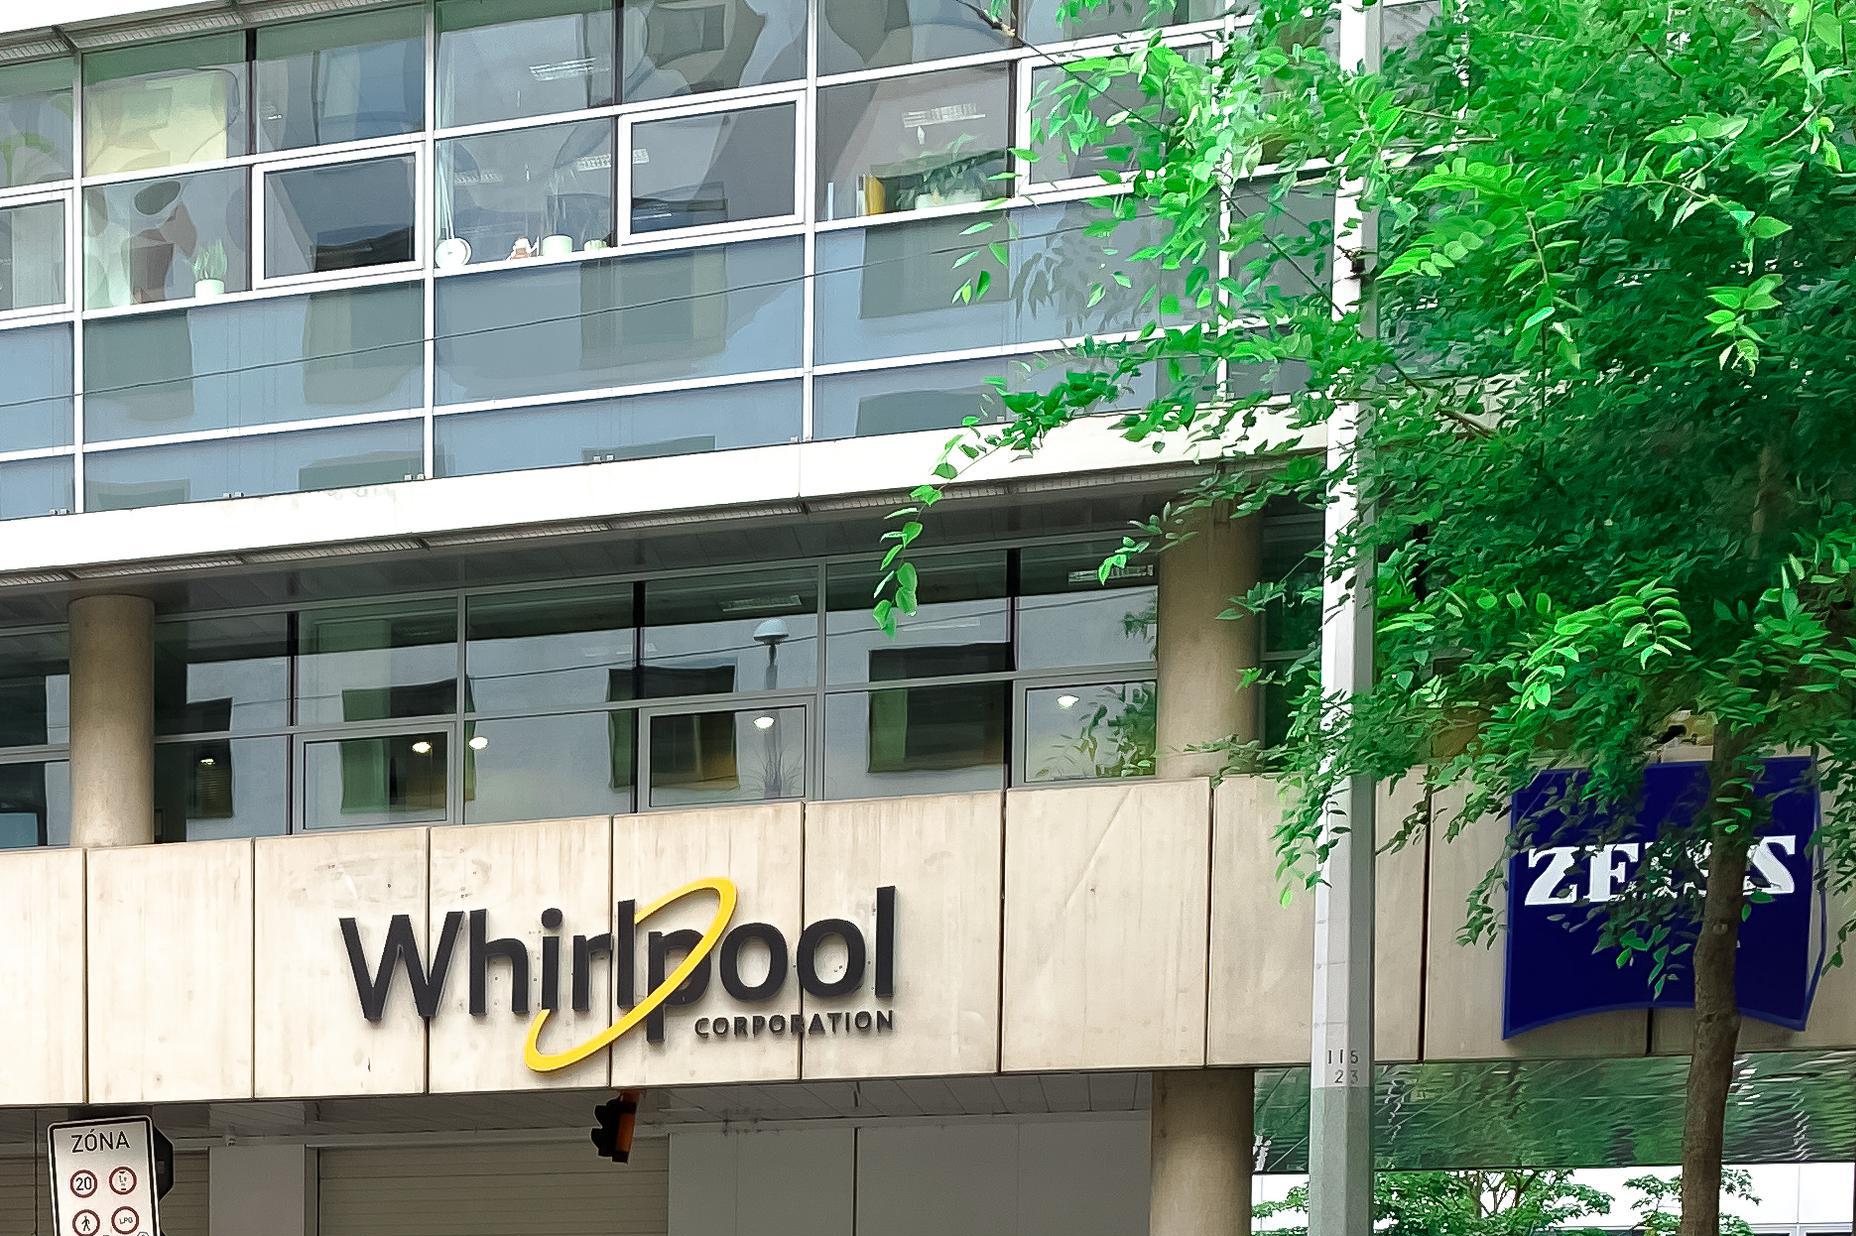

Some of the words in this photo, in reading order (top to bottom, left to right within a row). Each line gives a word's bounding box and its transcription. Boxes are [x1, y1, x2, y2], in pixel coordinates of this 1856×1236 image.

[338, 886, 897, 1044] Whirlpool
[693, 1010, 895, 1039] CORPORATION
[1334, 1069, 1359, 1085] 23
[71, 1128, 131, 1153] ZÓNA
[75, 1176, 93, 1192] 20
